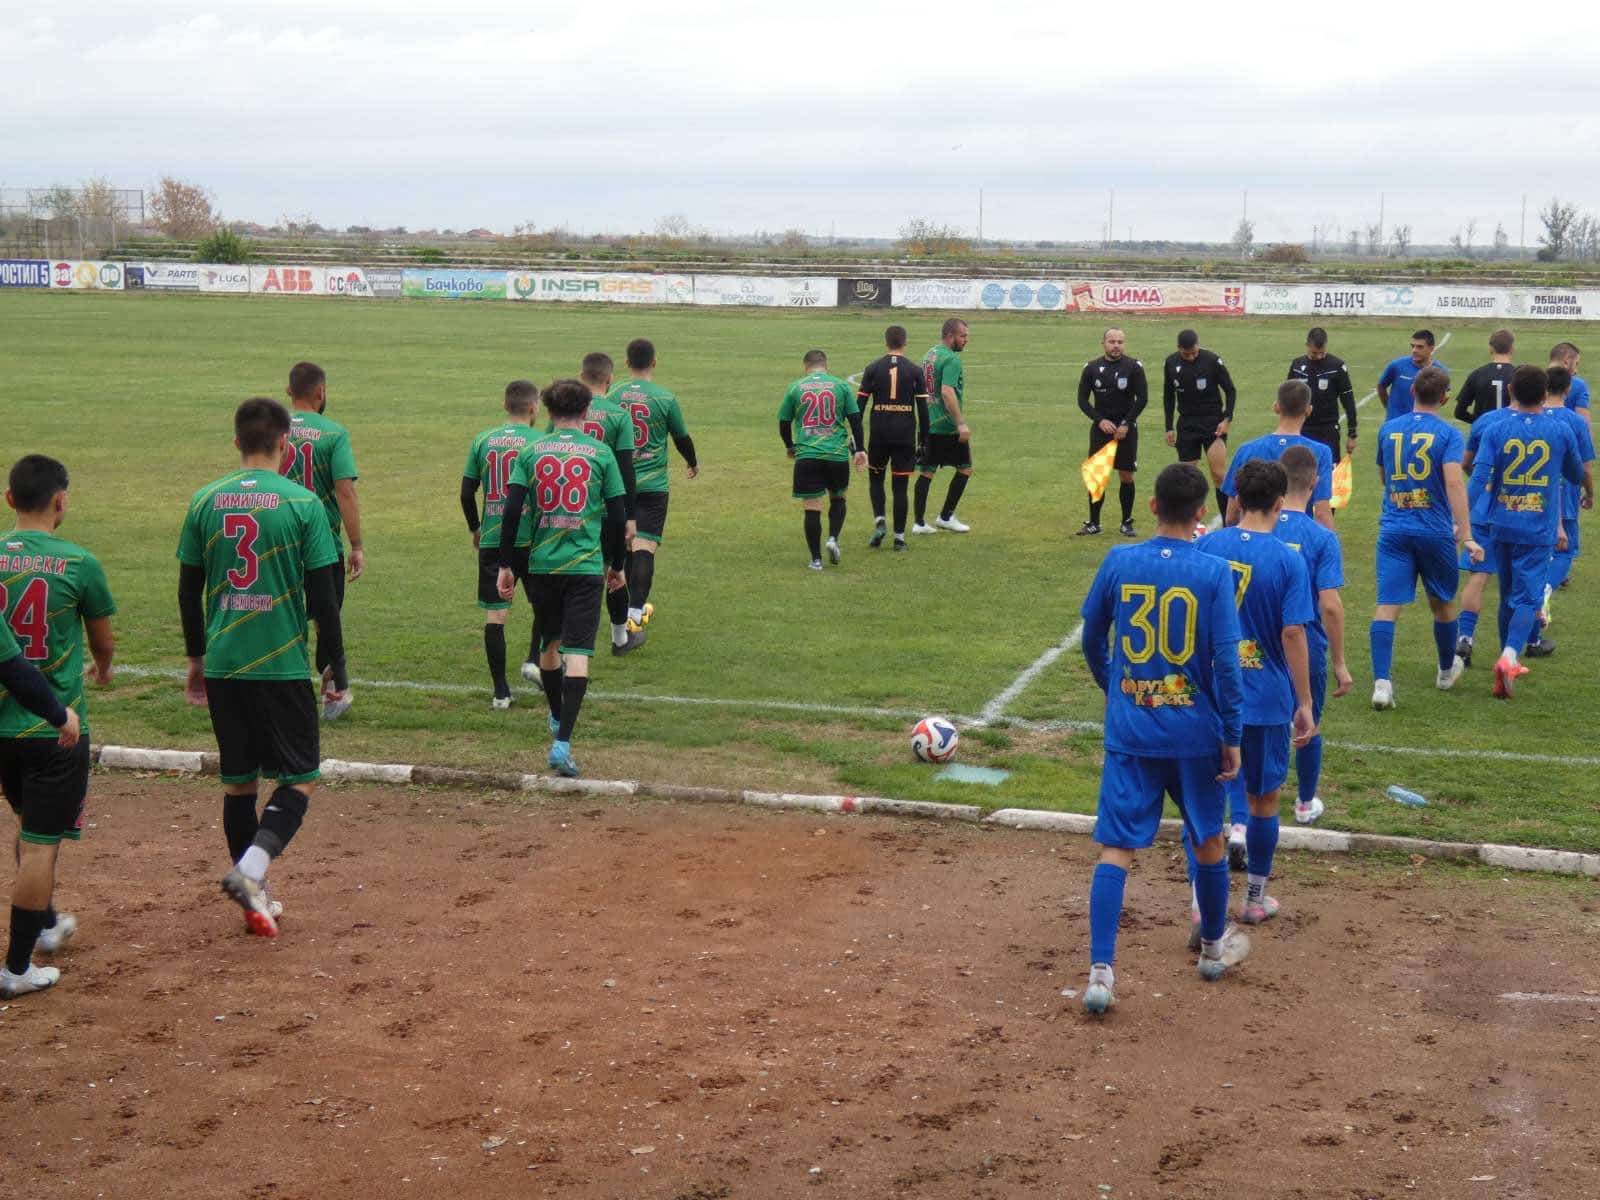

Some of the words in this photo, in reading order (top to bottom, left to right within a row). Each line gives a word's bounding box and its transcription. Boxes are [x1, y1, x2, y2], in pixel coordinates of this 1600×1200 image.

[40, 264, 49, 284] 5
[219, 275, 247, 283] LUCA
[263, 268, 313, 291] ABB
[425, 277, 484, 292] Бачково
[1105, 287, 1162, 304] ЦИМА
[1313, 292, 1365, 308] ВАНИЧ
[1534, 295, 1577, 304] ОБЩИНА
[1530, 305, 1582, 314] РАКОВСКИ
[889, 366, 898, 400] 1
[800, 390, 837, 428] 20
[1389, 432, 1435, 480] 13
[1503, 438, 1550, 486] 22
[534, 454, 592, 513] 88
[213, 492, 280, 511] ДИМИТРОВ
[223, 513, 260, 590] 3
[1120, 583, 1199, 666] 30
